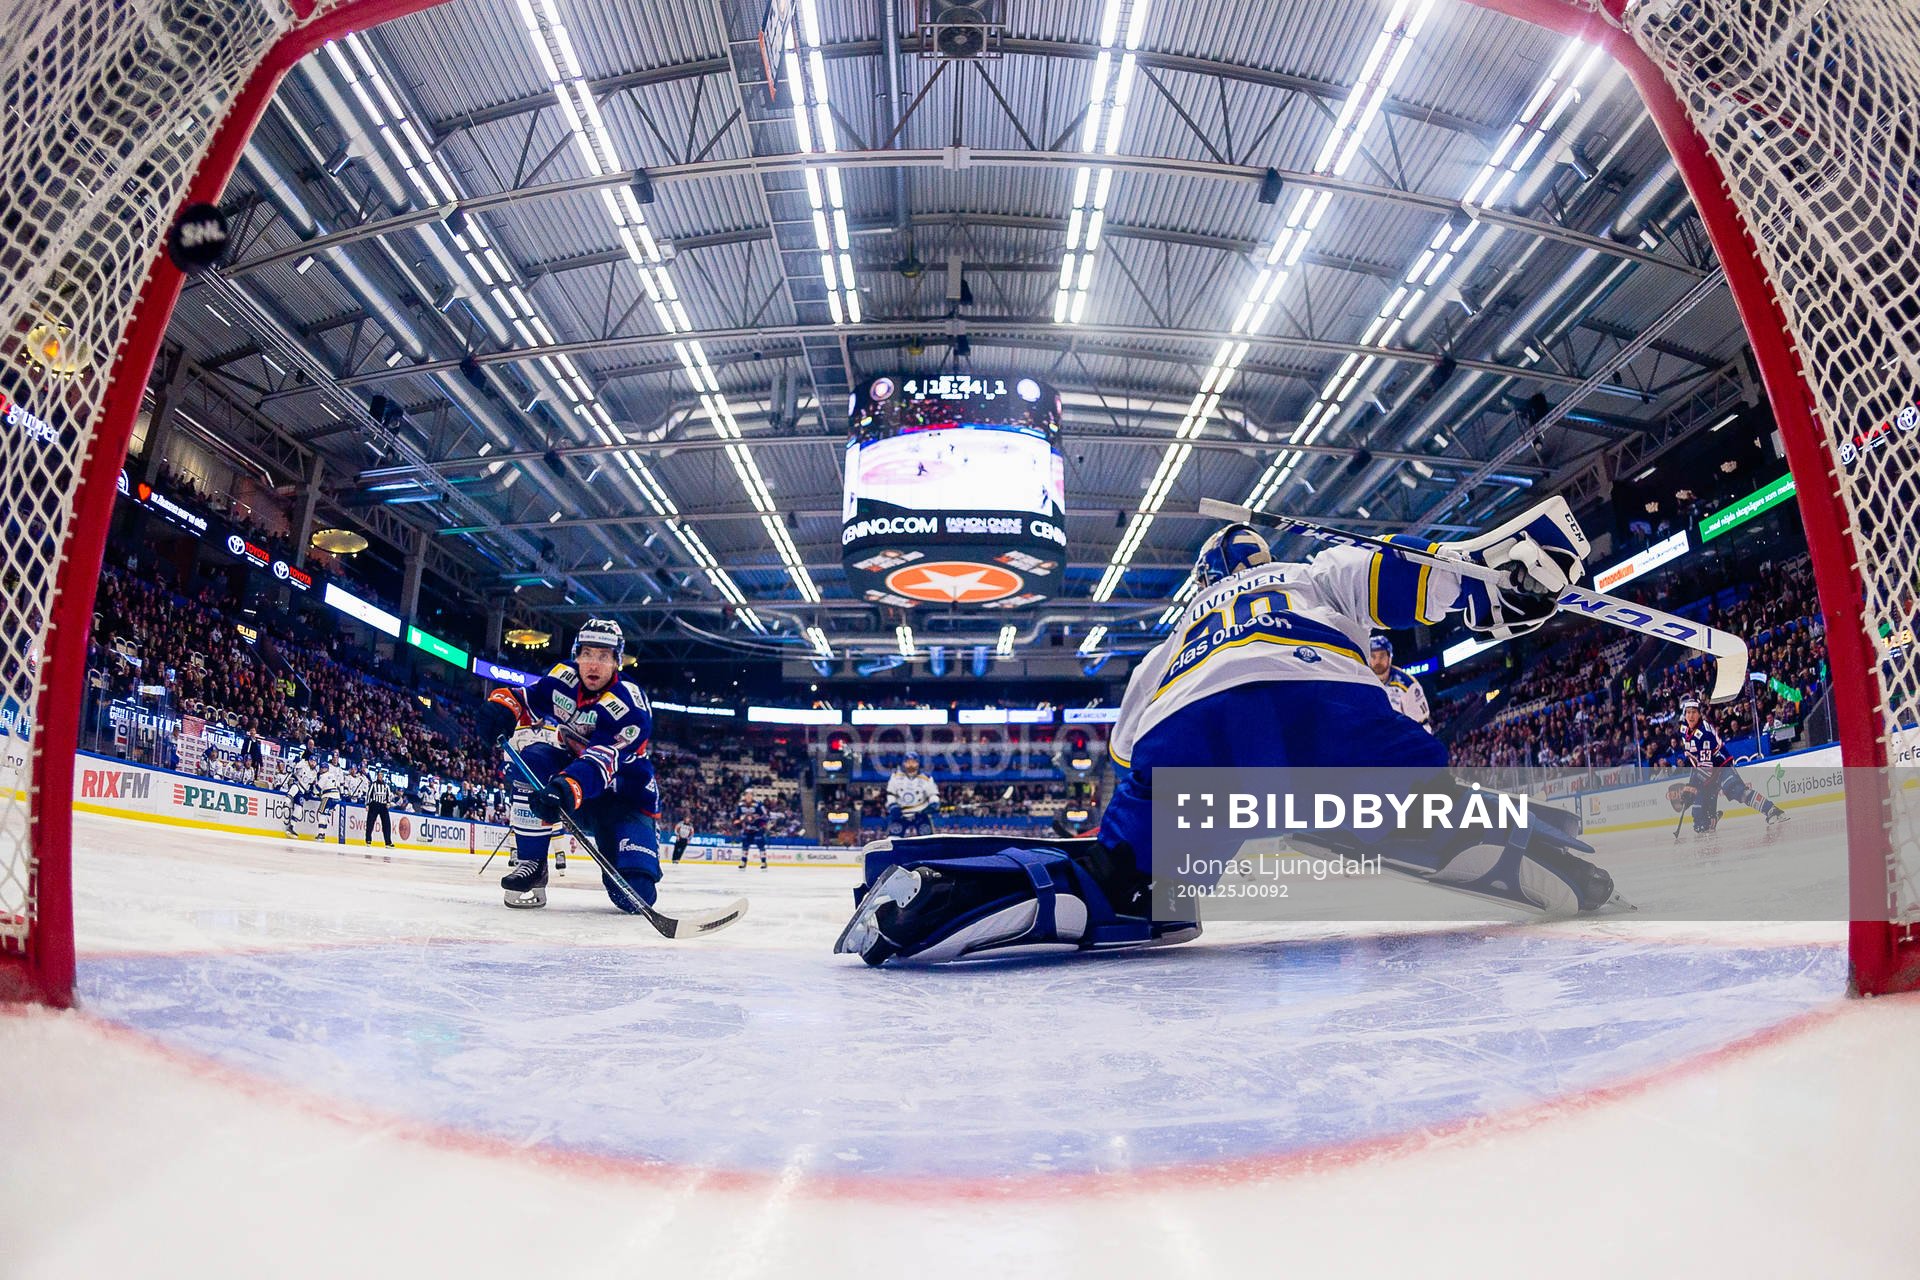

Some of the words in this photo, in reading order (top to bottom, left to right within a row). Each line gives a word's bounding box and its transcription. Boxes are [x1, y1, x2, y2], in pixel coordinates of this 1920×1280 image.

[1565, 513, 1584, 542] CCM
[245, 541, 270, 562] TOYOTA
[289, 566, 312, 585] TOYOTA
[1557, 592, 1697, 642] CCM
[1700, 750, 1712, 761] 53
[1783, 771, 1844, 794] Växjöbostä
[183, 785, 248, 815] PEAB
[420, 818, 466, 843] dynacon
[1586, 818, 1607, 826] BALCO
